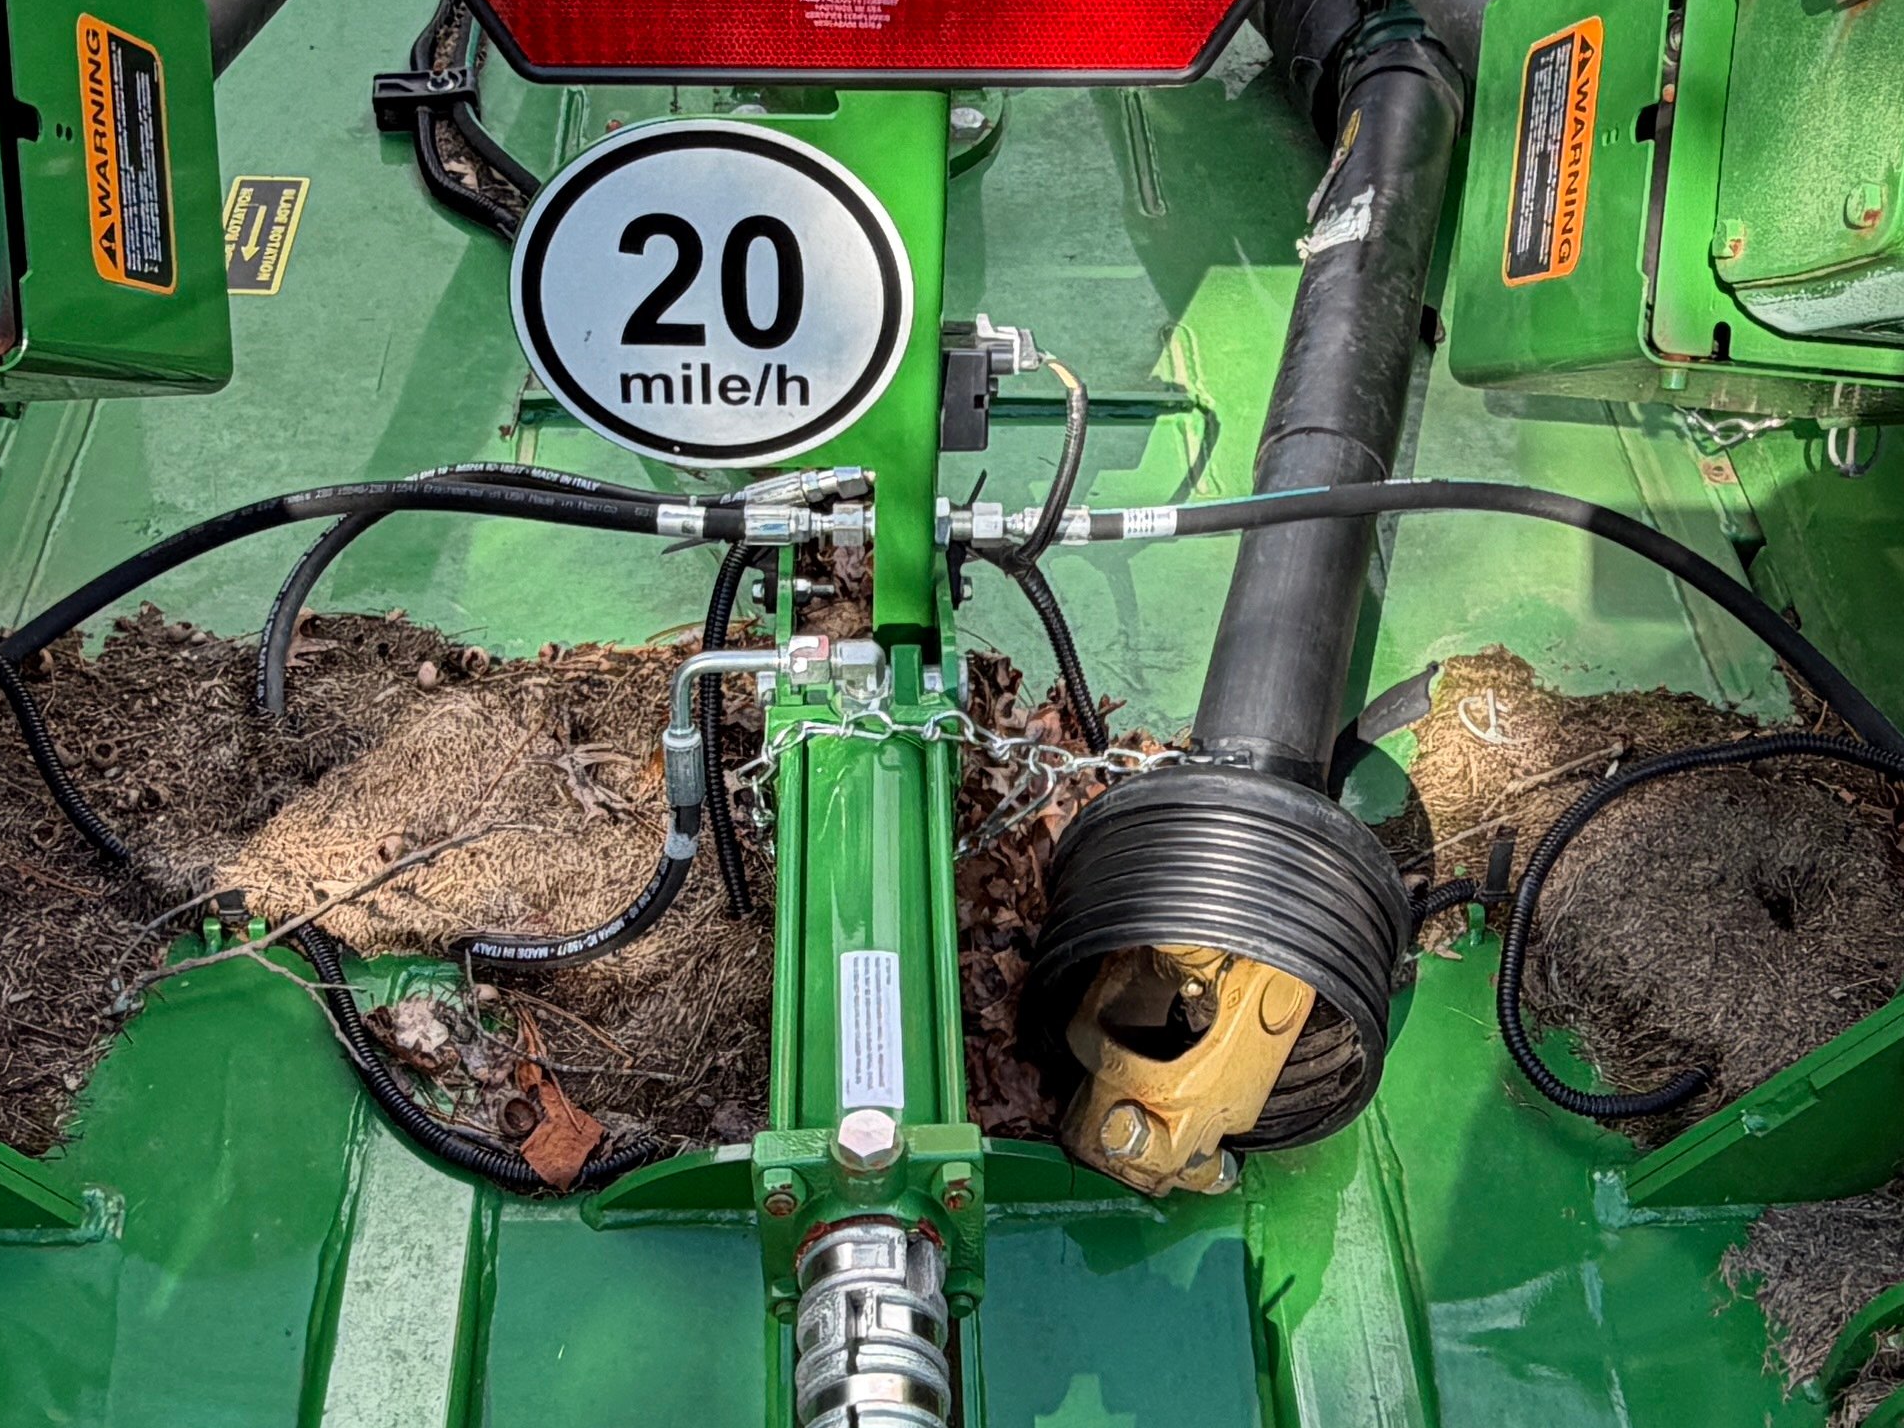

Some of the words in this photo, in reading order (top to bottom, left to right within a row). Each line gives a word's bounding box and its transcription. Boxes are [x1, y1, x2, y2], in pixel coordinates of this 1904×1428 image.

[85, 25, 113, 220] WARNING
[1557, 77, 1589, 264] WARNING
[619, 213, 804, 349] 20
[620, 363, 810, 406] mile/h
[572, 476, 601, 491] ITALY
[471, 942, 502, 959] ITALY
[516, 946, 549, 962] MADE
